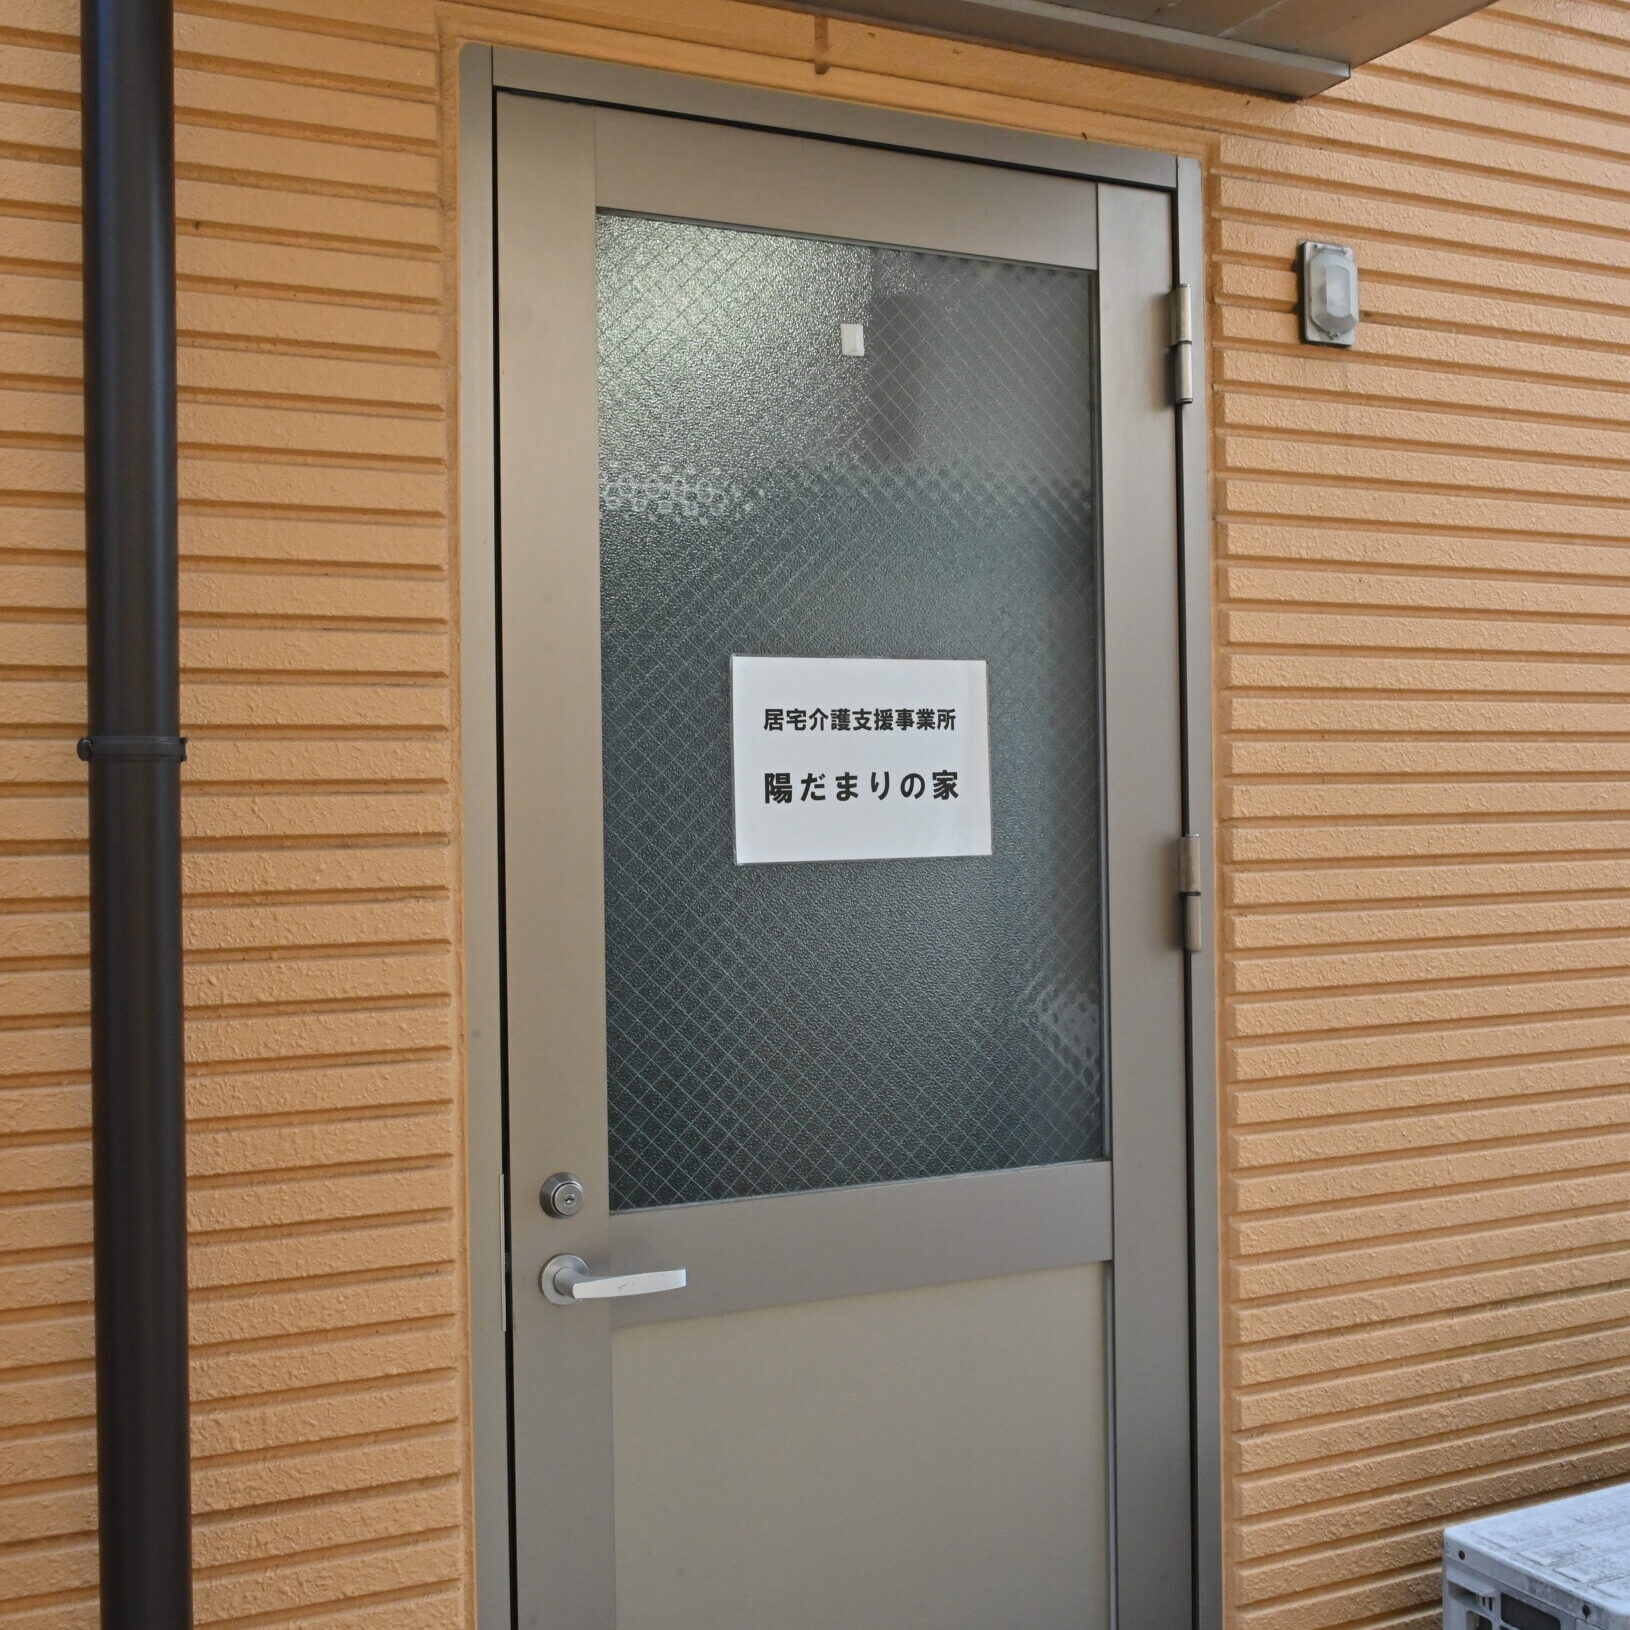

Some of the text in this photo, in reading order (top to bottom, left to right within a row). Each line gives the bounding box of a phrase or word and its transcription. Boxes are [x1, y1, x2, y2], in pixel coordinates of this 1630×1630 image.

[763, 707, 957, 732] 居宅介護支援事業所
[764, 769, 959, 804] 陽だまりの家
